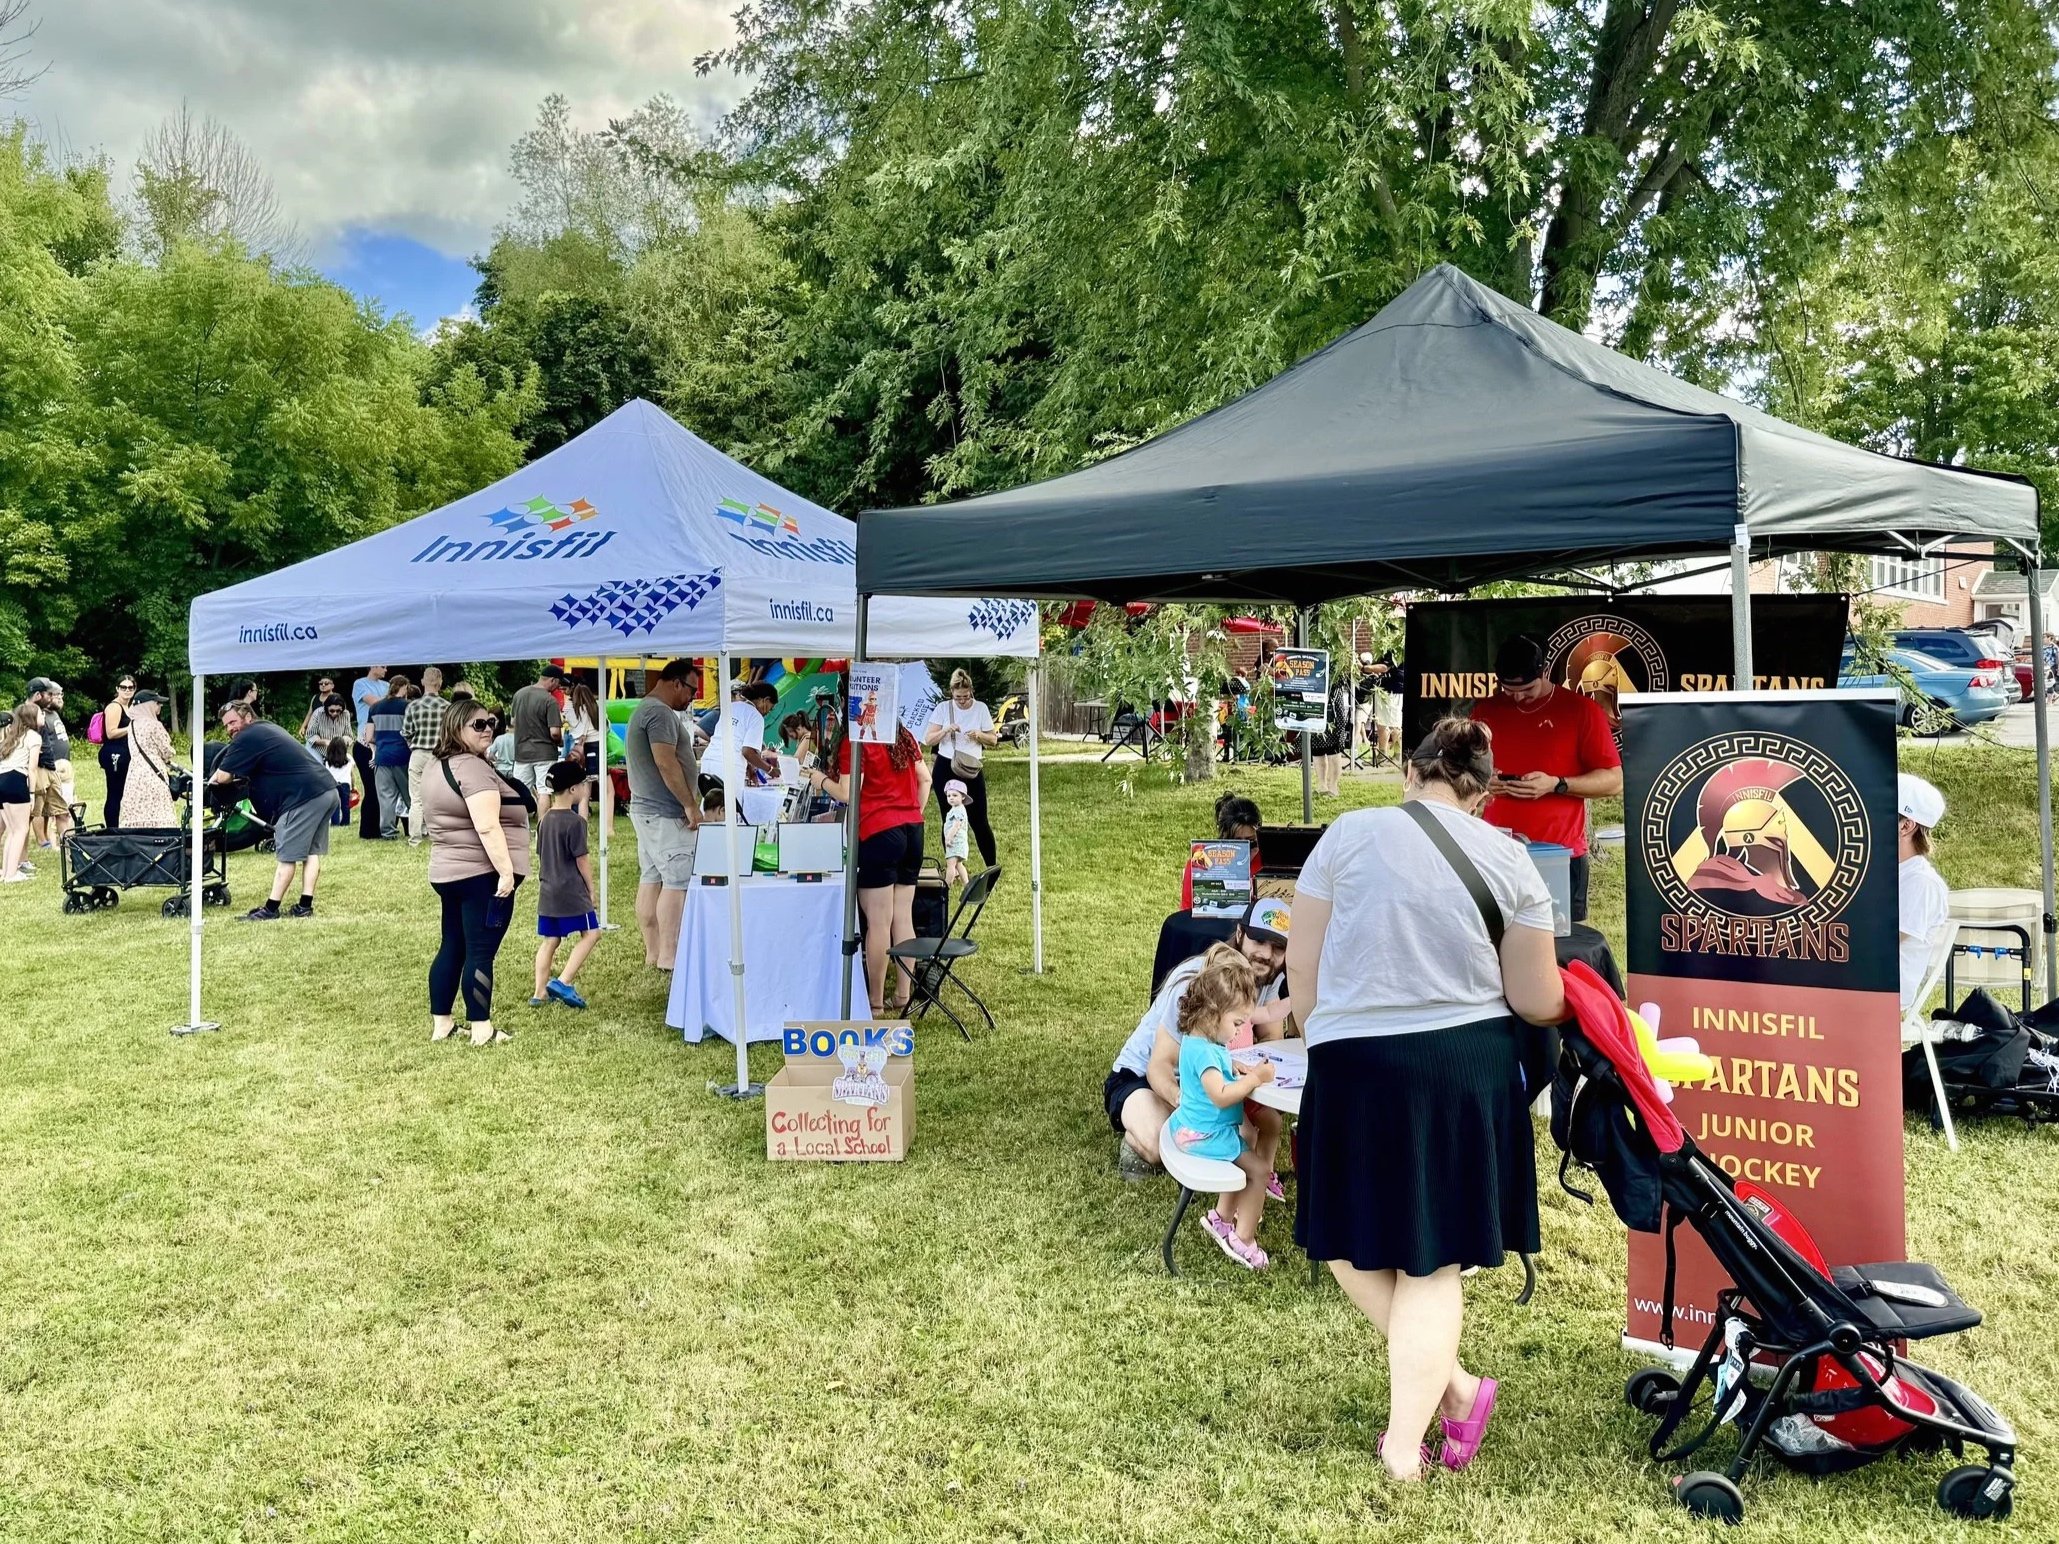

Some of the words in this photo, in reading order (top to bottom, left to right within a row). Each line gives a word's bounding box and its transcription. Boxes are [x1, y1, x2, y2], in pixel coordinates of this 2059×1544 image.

[410, 530, 618, 563] Innisfil
[769, 598, 833, 622] innisfil.ca
[238, 622, 318, 644] innisfil.ca
[1289, 660, 1315, 670] SEASON
[1295, 669, 1311, 677] PASS
[1420, 672, 1504, 698] INNISF
[1680, 673, 1825, 692] SPATANS
[1208, 849, 1236, 858] SEASON
[1661, 913, 1850, 963] SPARTANS
[1692, 1006, 1825, 1040] INNISFIL
[1668, 1055, 1860, 1108] ARTANS
[771, 1109, 862, 1141] Collecting
[866, 1106, 892, 1132] for
[1697, 1112, 1816, 1149] JUNIOR
[776, 1140, 787, 1156] a
[794, 1136, 841, 1156] Local
[844, 1135, 892, 1156] School
